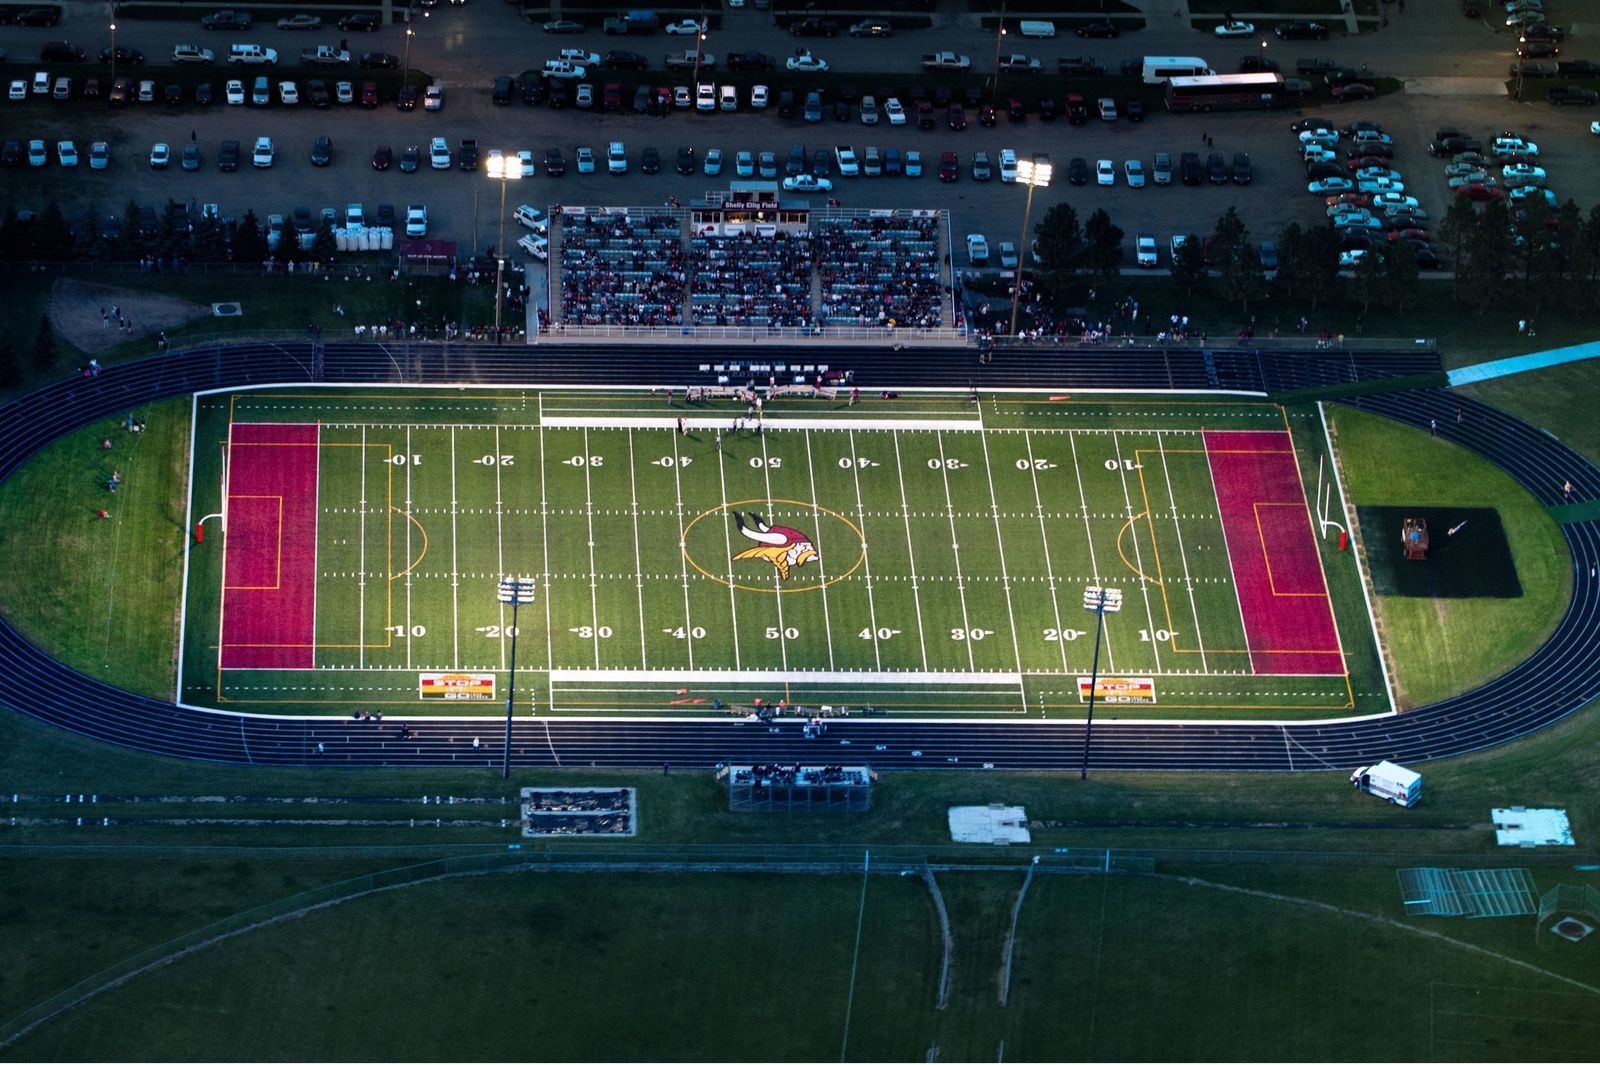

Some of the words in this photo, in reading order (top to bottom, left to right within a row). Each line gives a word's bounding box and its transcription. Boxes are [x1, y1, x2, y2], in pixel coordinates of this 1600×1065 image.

[725, 201, 745, 209] Shelly
[392, 454, 422, 466] 10
[481, 454, 515, 466] 20
[570, 455, 604, 467] 30
[660, 456, 693, 468] 40
[749, 457, 782, 468] 50
[838, 457, 871, 469] 40
[927, 458, 960, 470] 30
[1015, 458, 1049, 471] 20
[1104, 459, 1135, 471] 10
[394, 625, 427, 638] 10
[485, 625, 521, 638] 20
[578, 626, 613, 639] 30
[672, 626, 707, 639] 40
[765, 627, 800, 640] 50
[858, 627, 893, 640] 40
[950, 628, 986, 641] 30
[1042, 628, 1079, 642] 20
[1138, 628, 1171, 642] 10
